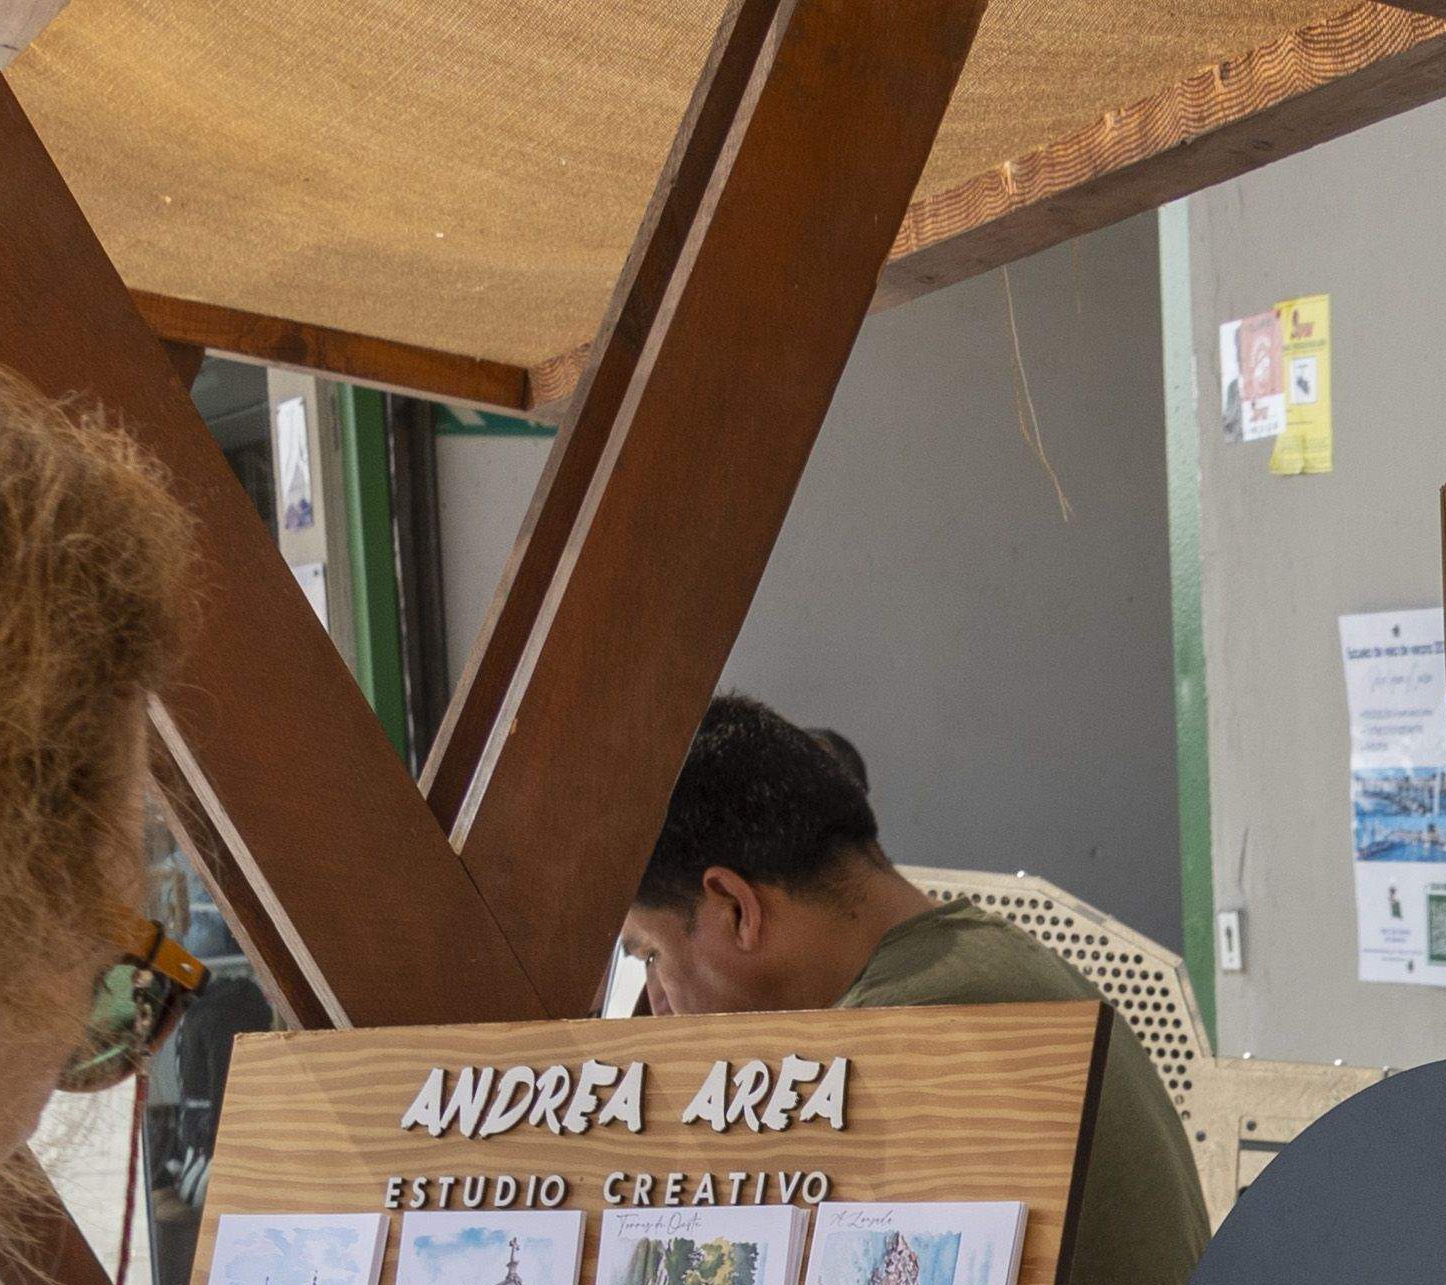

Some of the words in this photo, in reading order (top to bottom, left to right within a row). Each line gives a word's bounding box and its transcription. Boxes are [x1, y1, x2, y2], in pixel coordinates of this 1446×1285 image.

[401, 1057, 645, 1139] ANDREA
[681, 1054, 851, 1132] AREA
[384, 1174, 569, 1209] ESTUDIO
[602, 1169, 832, 1205] CREATIVO
